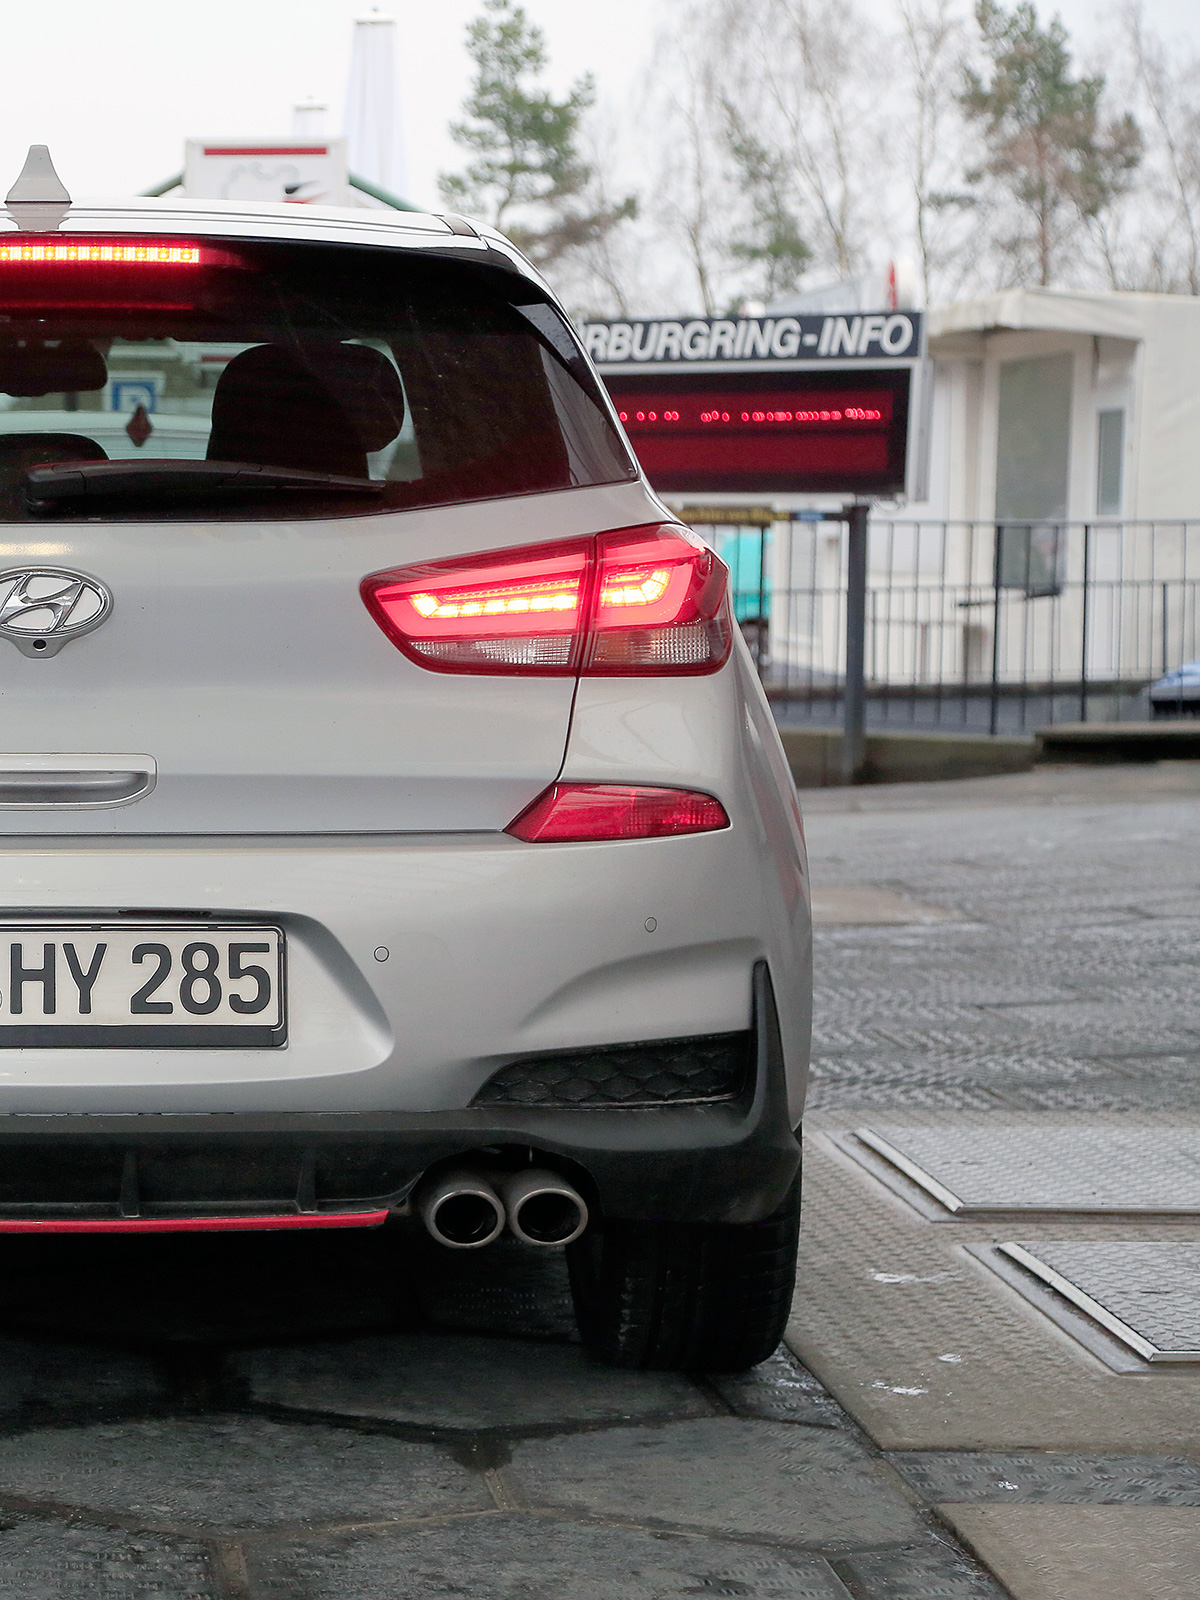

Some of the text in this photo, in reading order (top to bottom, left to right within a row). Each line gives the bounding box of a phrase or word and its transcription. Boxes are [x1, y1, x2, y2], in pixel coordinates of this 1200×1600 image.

[578, 314, 914, 361] RBURGRING-INFO
[10, 943, 107, 1014] HY
[130, 942, 271, 1015] 285
